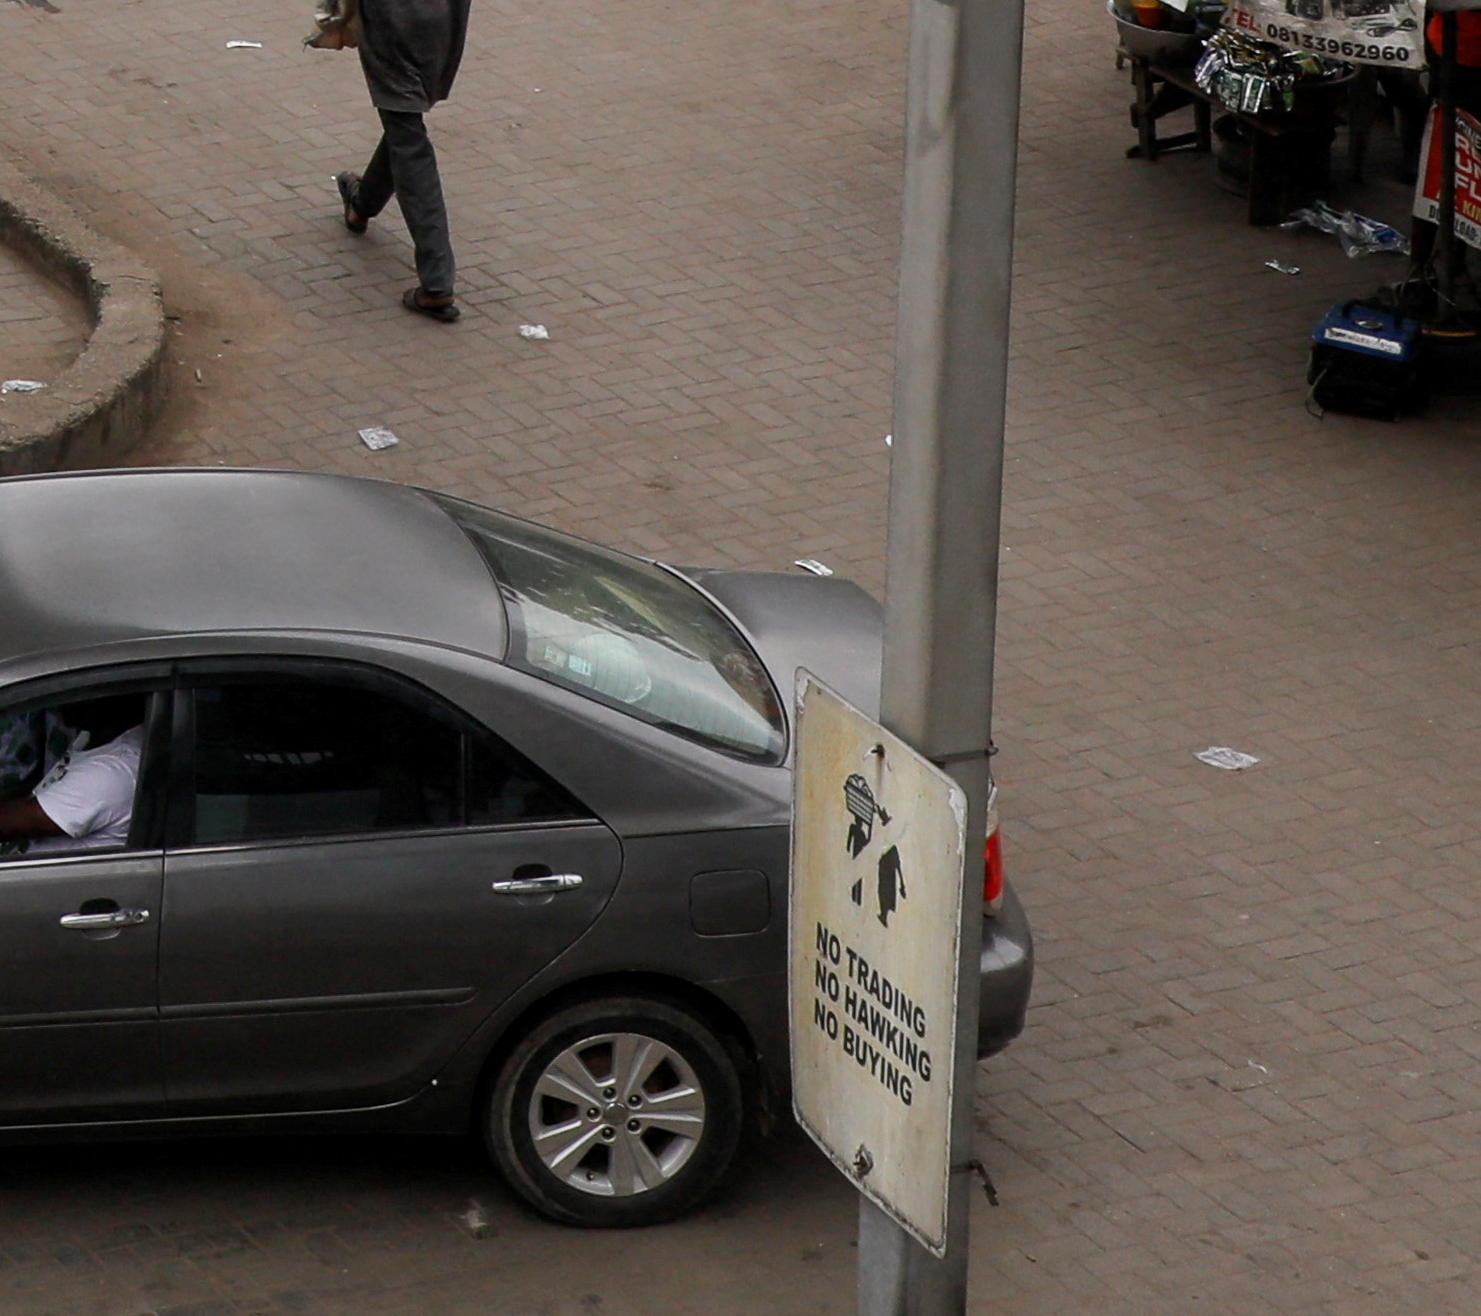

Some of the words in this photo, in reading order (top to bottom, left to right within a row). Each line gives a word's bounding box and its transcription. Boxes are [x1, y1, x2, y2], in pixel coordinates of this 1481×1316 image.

[1266, 23, 1410, 63] 08133962960
[815, 957, 841, 1007] NO
[844, 980, 933, 1084] HAWKING
[816, 920, 842, 967] NO
[845, 945, 927, 1040] TRADING
[814, 996, 839, 1043] NO
[842, 1024, 914, 1109] BUYING
